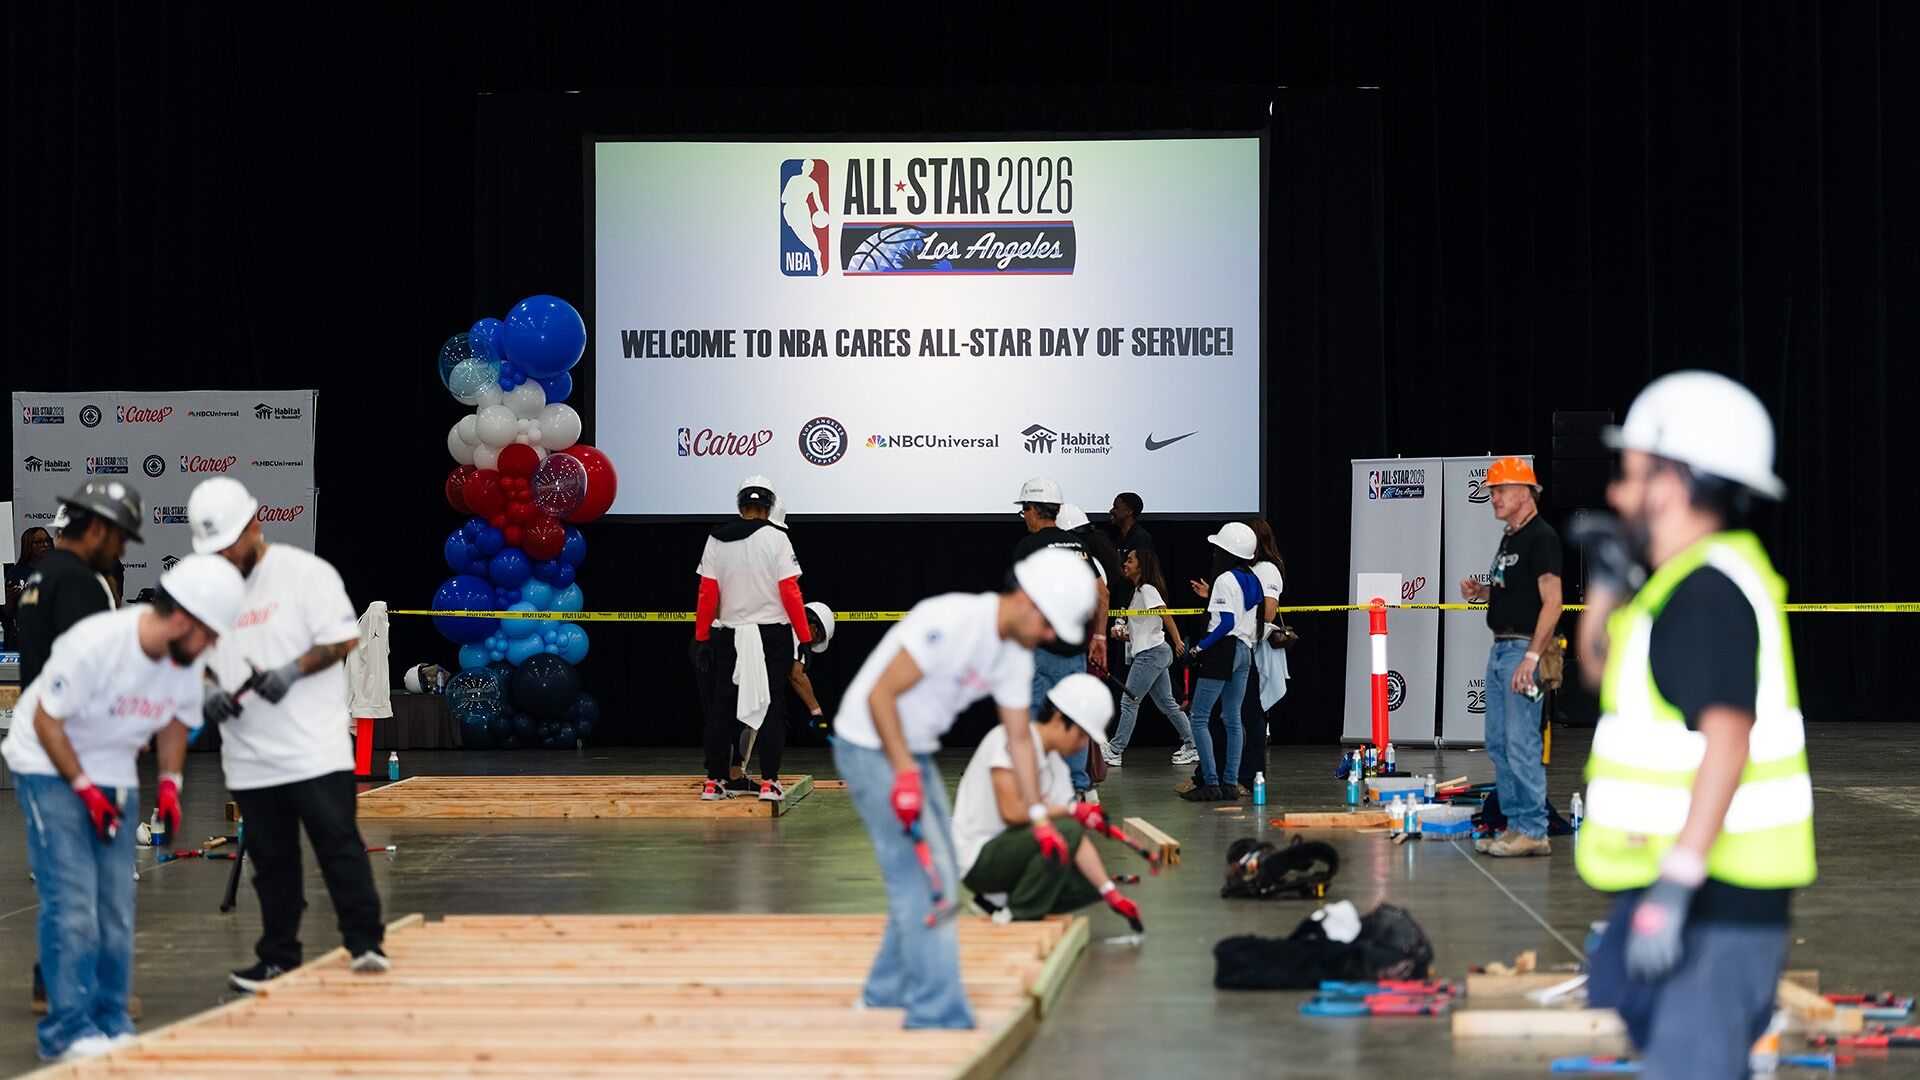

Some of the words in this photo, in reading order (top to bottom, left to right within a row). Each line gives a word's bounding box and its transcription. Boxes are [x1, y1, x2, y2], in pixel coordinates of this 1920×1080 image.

[997, 156, 1073, 214] 2026
[917, 231, 961, 260] Los
[966, 232, 1063, 269] Angeles
[785, 251, 811, 272] NBA
[621, 329, 736, 359] WELCOME
[743, 329, 773, 358] TO
[779, 329, 829, 358] NBA
[835, 328, 911, 358] CARES
[918, 328, 1032, 357] ALL-STAR
[1039, 327, 1090, 356] DAY
[1097, 327, 1125, 356] OF
[1131, 326, 1233, 356] SERVICE!
[126, 405, 164, 423] Cares
[816, 419, 844, 436] ANGELES
[693, 428, 758, 456] Cares
[889, 434, 999, 448] NBCUniversal
[1061, 432, 1110, 446] Habitat
[1061, 446, 1072, 454] for
[1074, 446, 1110, 456] Humanity
[190, 456, 228, 472] Cares
[1410, 469, 1424, 484] 2026
[257, 505, 295, 522] Cares
